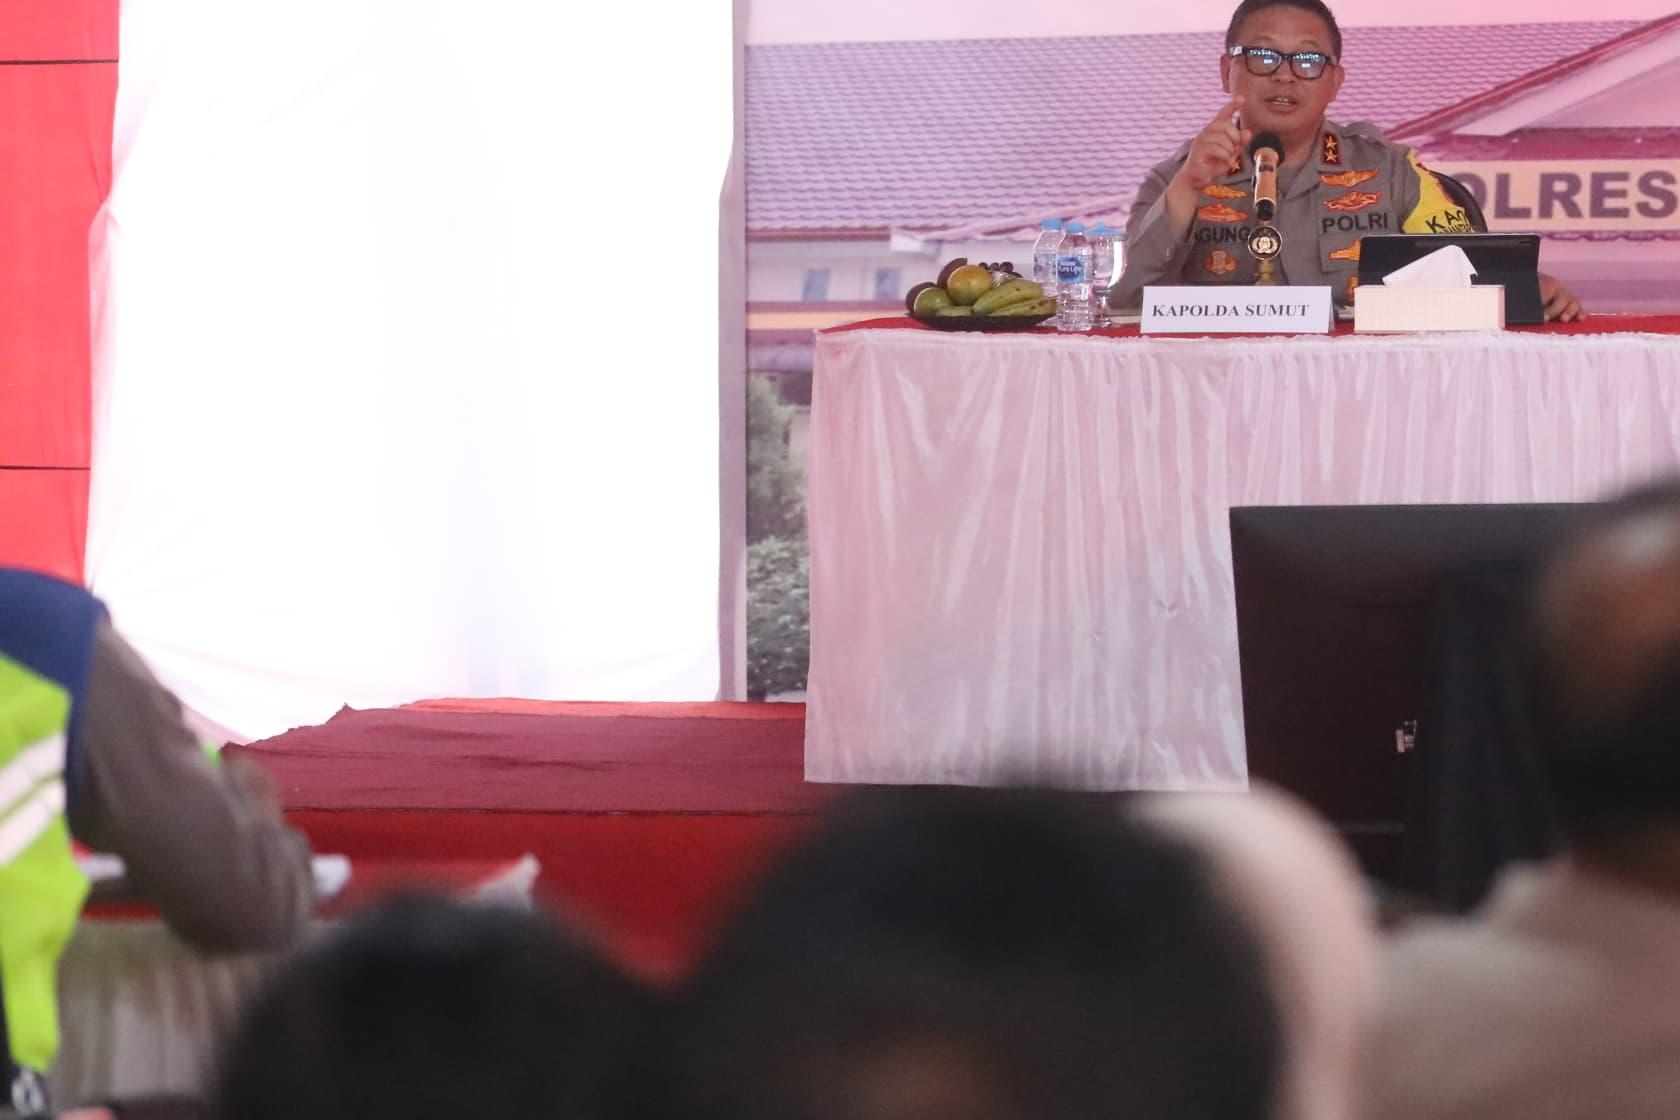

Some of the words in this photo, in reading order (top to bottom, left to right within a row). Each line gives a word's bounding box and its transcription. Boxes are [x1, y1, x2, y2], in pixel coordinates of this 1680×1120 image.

[1321, 212, 1388, 233] POLRI
[1152, 304, 1239, 317] KAPOLDA
[1244, 304, 1309, 317] SUMUT
